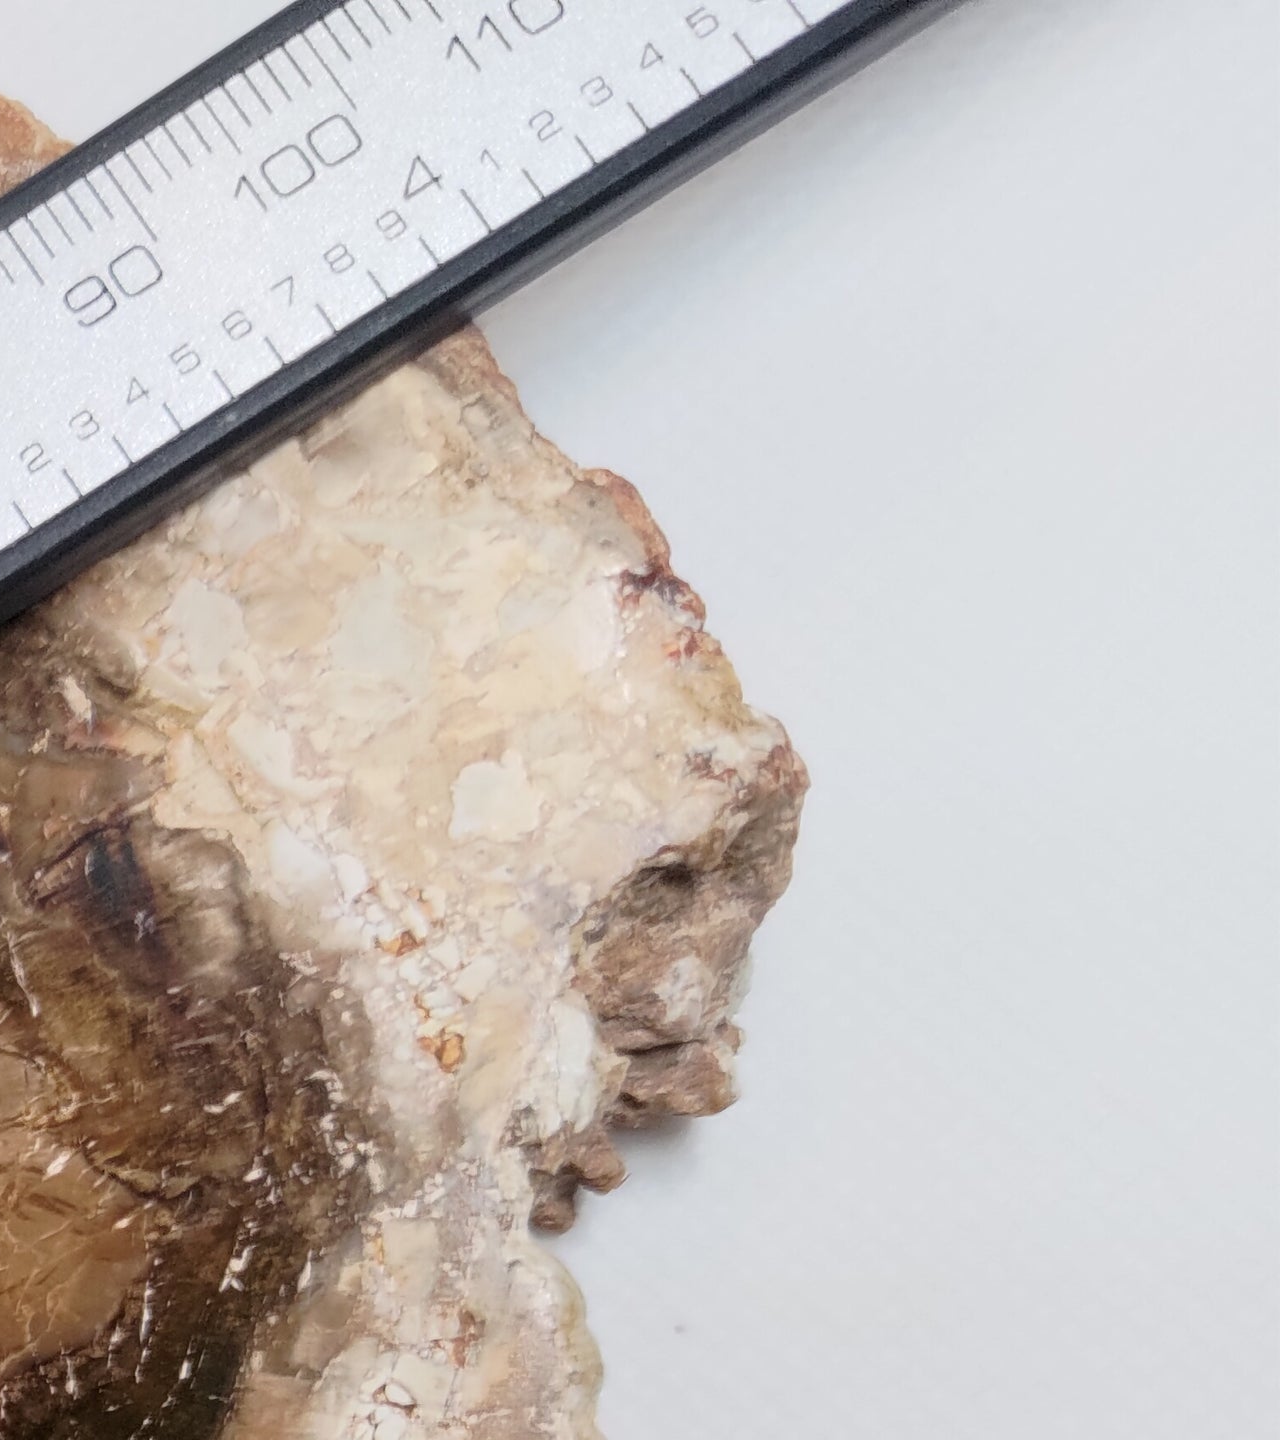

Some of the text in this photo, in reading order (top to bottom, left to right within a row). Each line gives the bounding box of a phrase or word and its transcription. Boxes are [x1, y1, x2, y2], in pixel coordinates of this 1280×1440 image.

[19, 442, 52, 472] 2
[71, 410, 101, 441] 3
[126, 378, 150, 406] 4
[169, 343, 201, 375] 5
[222, 310, 253, 342] 6
[270, 276, 297, 304] 7
[324, 243, 355, 274] 8
[375, 210, 407, 241] 9
[403, 155, 443, 200] 4
[480, 149, 500, 170] 1
[528, 110, 563, 142] 2
[580, 76, 614, 108] 3
[640, 42, 664, 69] 4
[685, 6, 721, 39] 5
[65, 245, 163, 327] 90
[234, 114, 363, 211] 100
